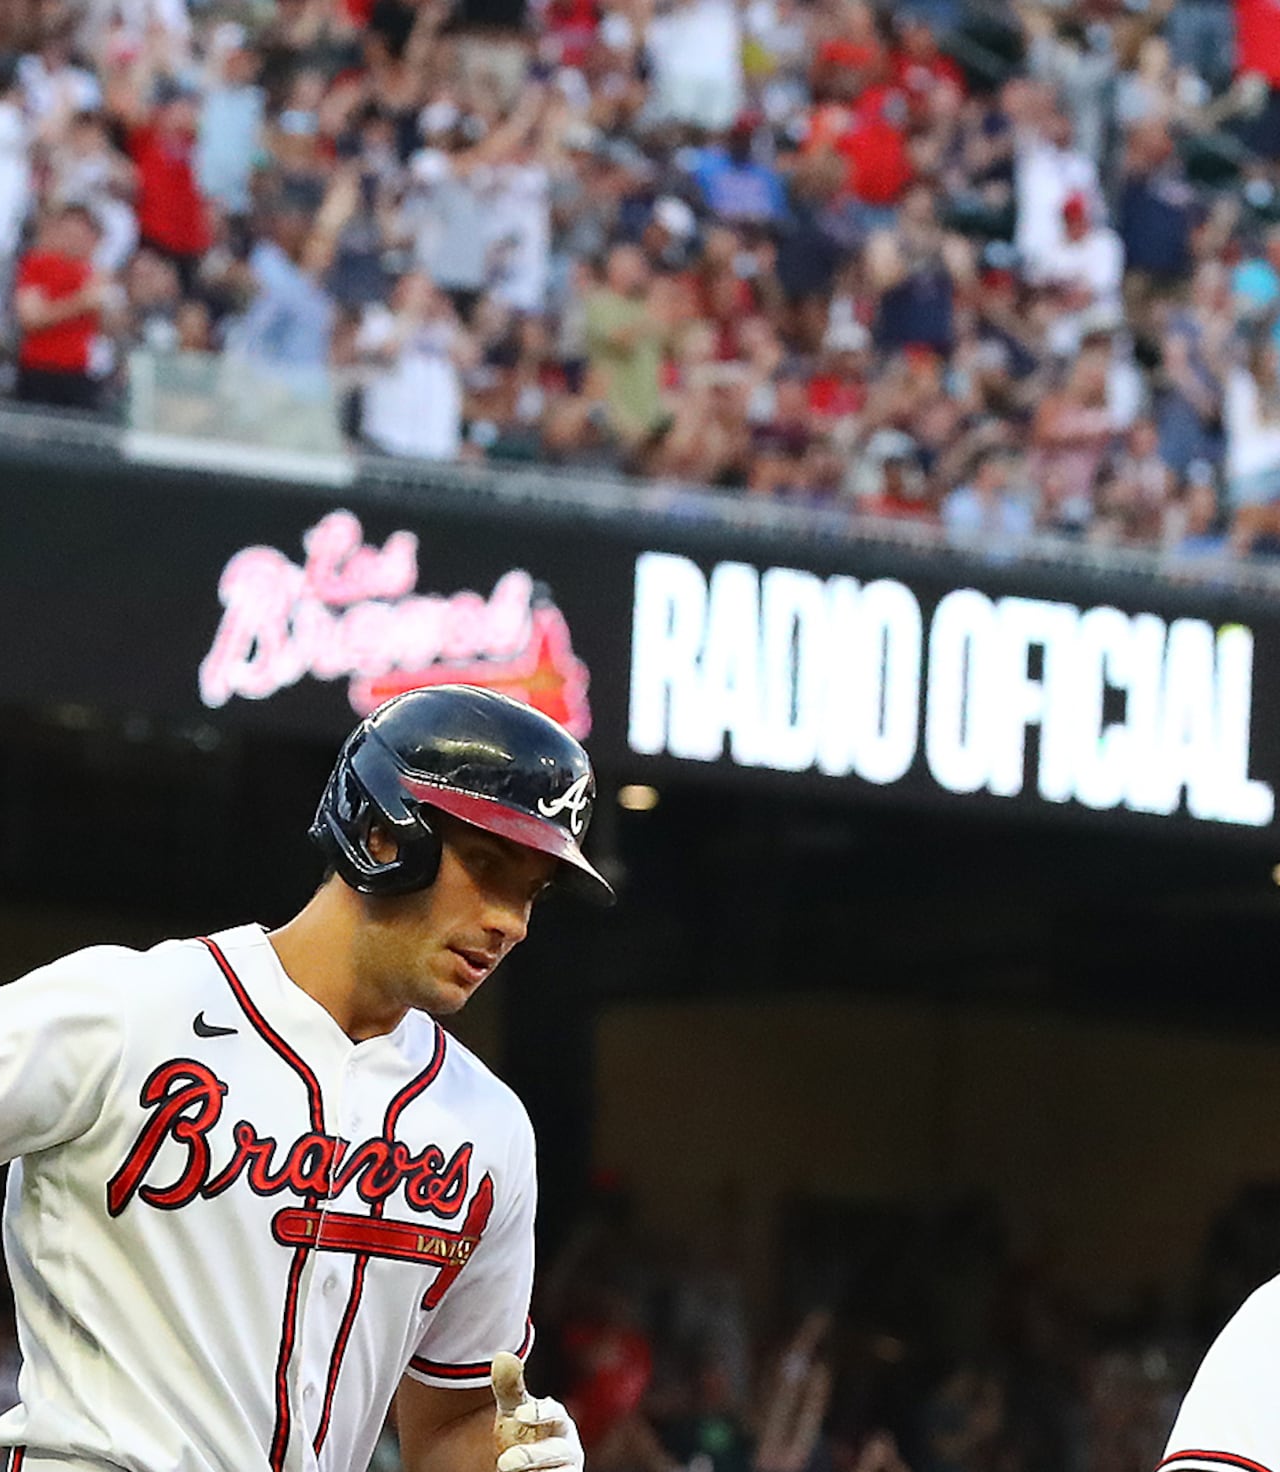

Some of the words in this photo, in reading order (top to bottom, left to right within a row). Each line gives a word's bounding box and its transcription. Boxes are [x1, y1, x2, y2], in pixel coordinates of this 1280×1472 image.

[627, 550, 922, 785] RADIO
[926, 588, 1276, 827] OFICIAL
[106, 1057, 474, 1220] Braves
